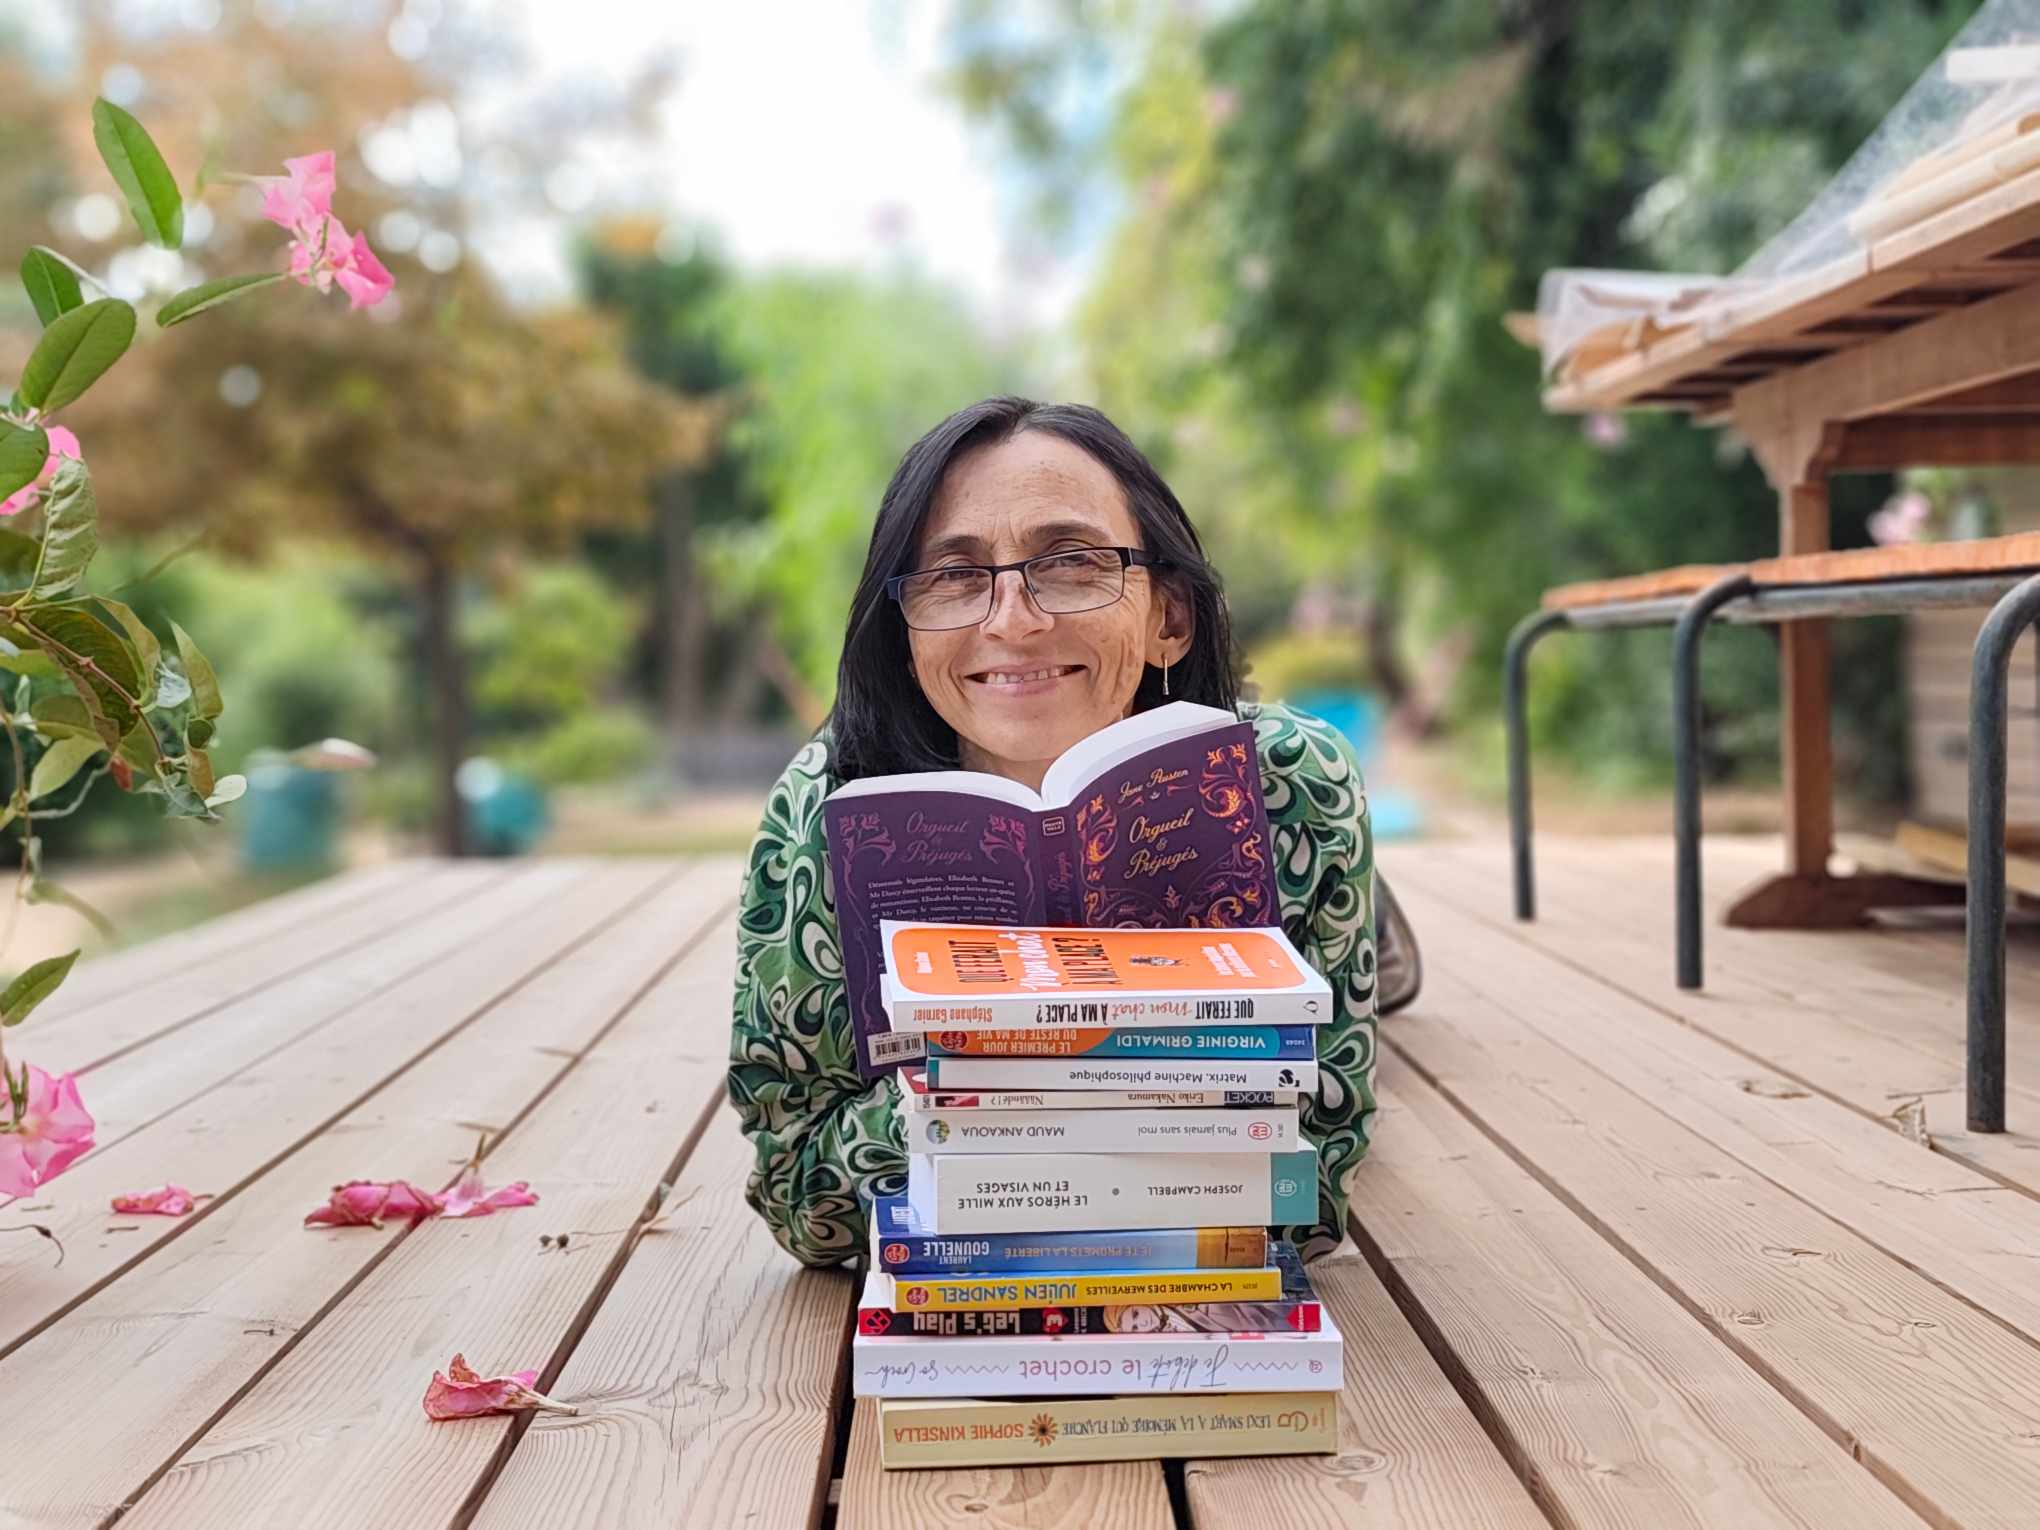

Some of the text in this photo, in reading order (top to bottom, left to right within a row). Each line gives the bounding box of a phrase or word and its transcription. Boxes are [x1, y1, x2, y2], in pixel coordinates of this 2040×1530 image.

[1118, 768, 1189, 801] Jane Austen
[1129, 807, 1194, 844] Orgueil
[1156, 838, 1168, 851] &
[1124, 845, 1200, 880] Préjugés
[912, 1007, 993, 1023] Stéphane Garnier
[1036, 1004, 1042, 1023] ?
[1046, 1004, 1078, 1022] PLACE
[1081, 1003, 1098, 1022] MA
[1101, 1003, 1108, 1025] À
[1112, 1002, 1145, 1021] chat
[1196, 999, 1233, 1020] FERAIT
[1234, 998, 1254, 1019] QUE
[976, 1029, 1077, 1040] DU RESTE DE MA VIE
[1116, 1034, 1266, 1048] VIRGINIE GRIMALDI
[983, 1041, 1071, 1053] LE PREMIER JOUR
[1069, 1069, 1151, 1082] philosophique
[1154, 1071, 1202, 1084] Machine
[1127, 1092, 1176, 1104] Nakamura
[1178, 1092, 1204, 1104] Eriko
[1225, 1091, 1274, 1104] POCKET
[961, 1126, 1065, 1137] MAUD ANKAOUA
[1138, 1125, 1237, 1137] Plus jamais sans moi
[976, 1180, 1069, 1193] ET UN VISAGES
[1147, 1184, 1243, 1196] JOSEPH CAMPBELL
[958, 1195, 1088, 1209] LE HÉROS AUX MILLE
[923, 1241, 990, 1257] GOUNELLE
[1004, 1247, 1048, 1260] LIBERTÉ
[939, 1256, 972, 1265] LAURENT
[1086, 1284, 1145, 1295] MERVEILLES
[1149, 1283, 1167, 1293] DES
[1169, 1282, 1218, 1293] CHAMBRE
[1220, 1282, 1233, 1292] LA
[937, 1286, 1018, 1303] SANDREL
[913, 1311, 1020, 1335] Let's Play
[1019, 1344, 1229, 1391] Je débute le crochet
[894, 1423, 1024, 1443] SOPHIE KINSELLA
